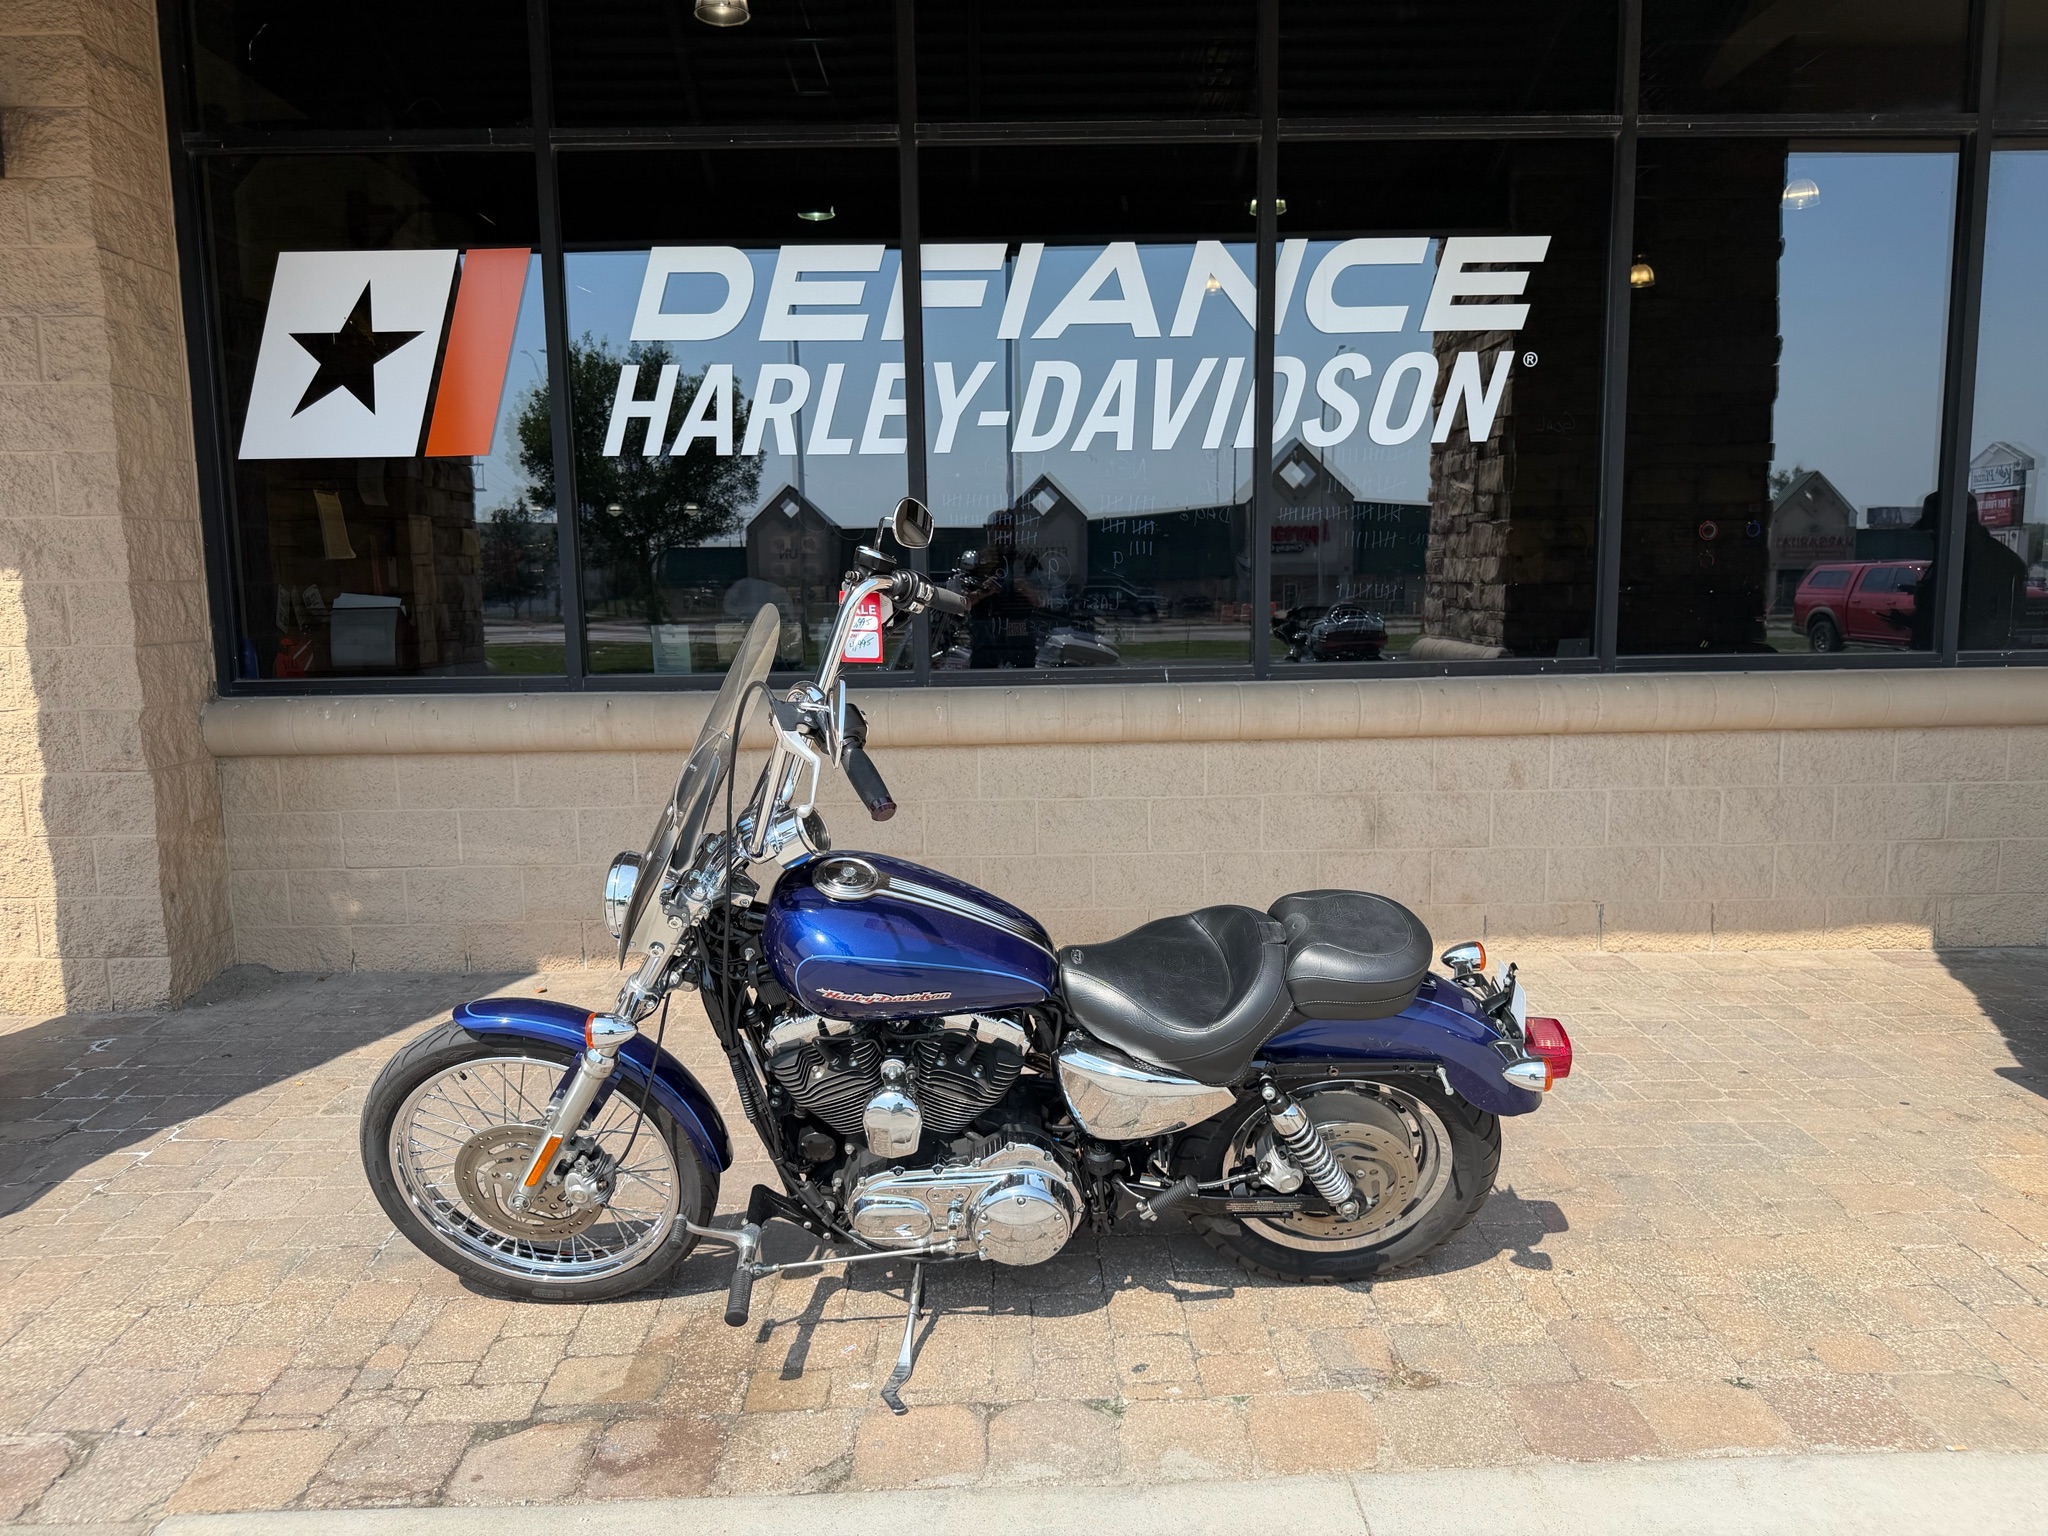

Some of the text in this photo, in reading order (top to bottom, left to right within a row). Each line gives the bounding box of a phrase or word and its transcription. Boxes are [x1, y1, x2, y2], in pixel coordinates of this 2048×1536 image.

[629, 235, 1551, 341] DEFIANCE
[603, 350, 1515, 457] HARLEY-DAVIDSON
[856, 604, 877, 616] LE
[816, 987, 952, 1005] Harley-Davidson
